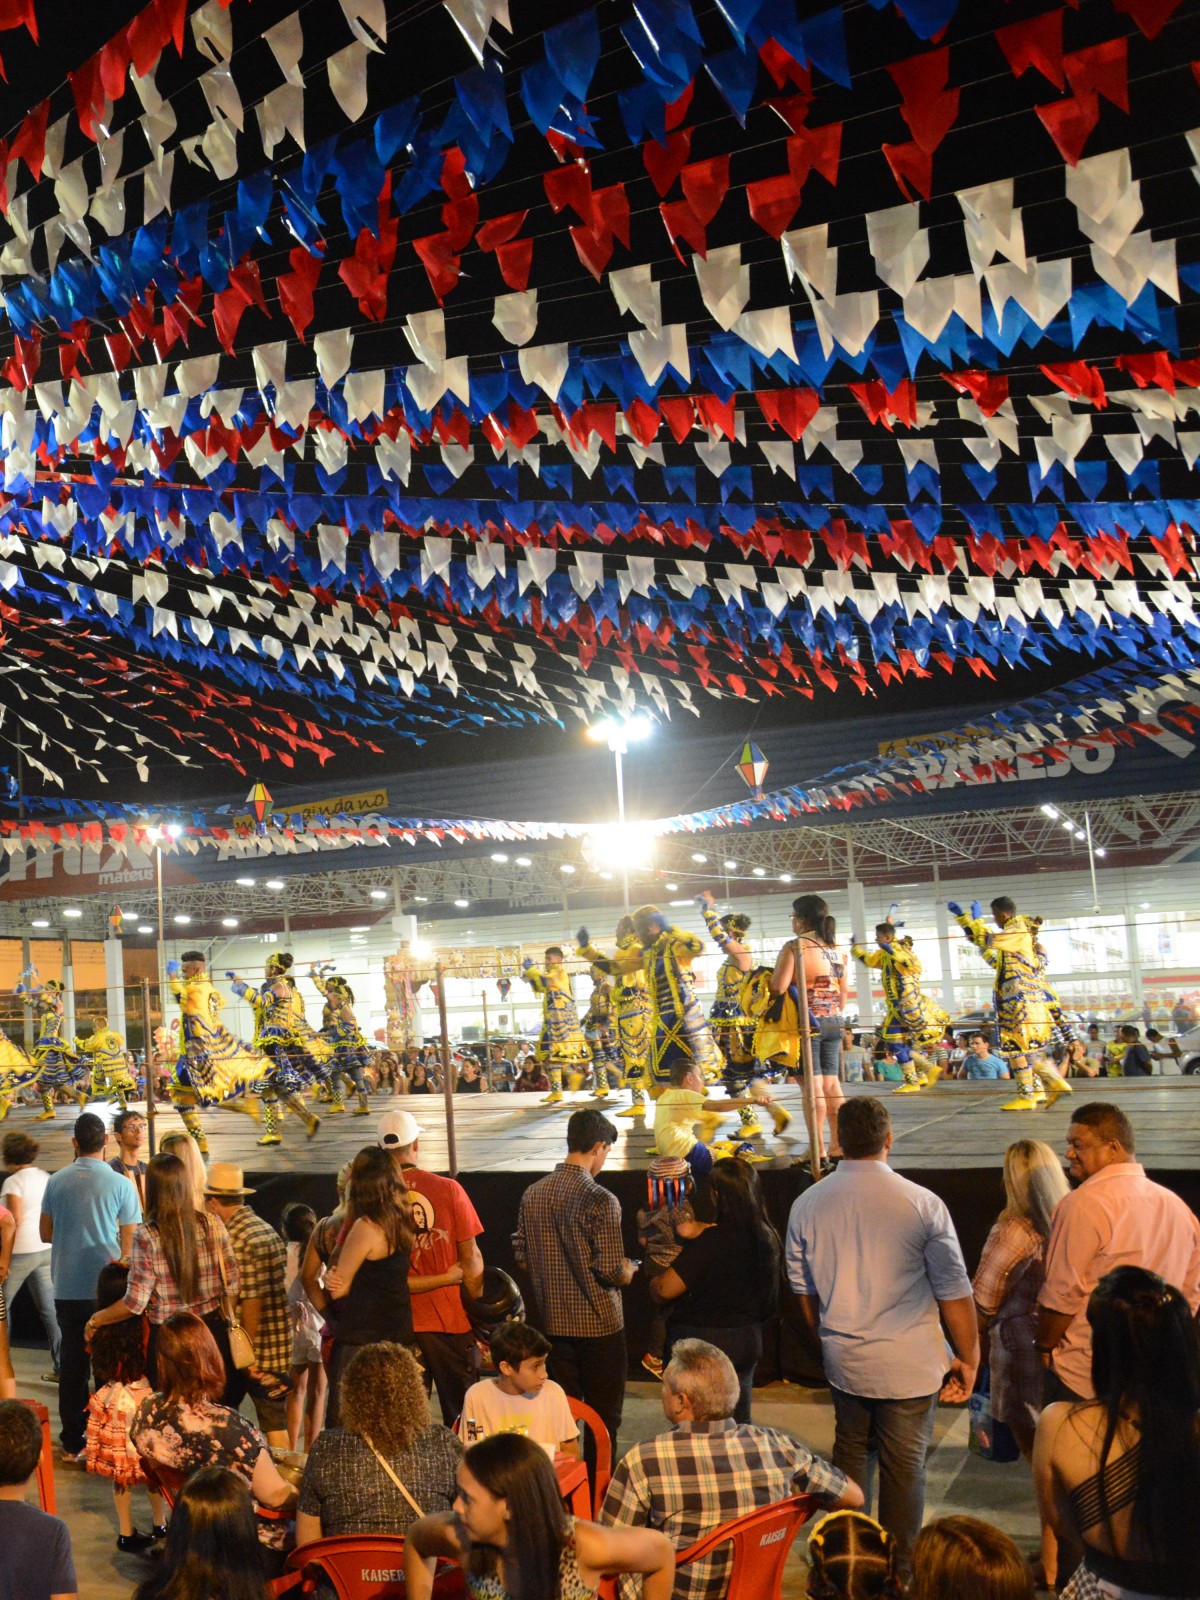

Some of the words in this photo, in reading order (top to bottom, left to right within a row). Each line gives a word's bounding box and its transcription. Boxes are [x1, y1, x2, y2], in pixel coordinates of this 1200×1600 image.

[358, 793, 385, 811] no
[99, 868, 154, 885] mateus
[361, 1568, 405, 1582] KAISER
